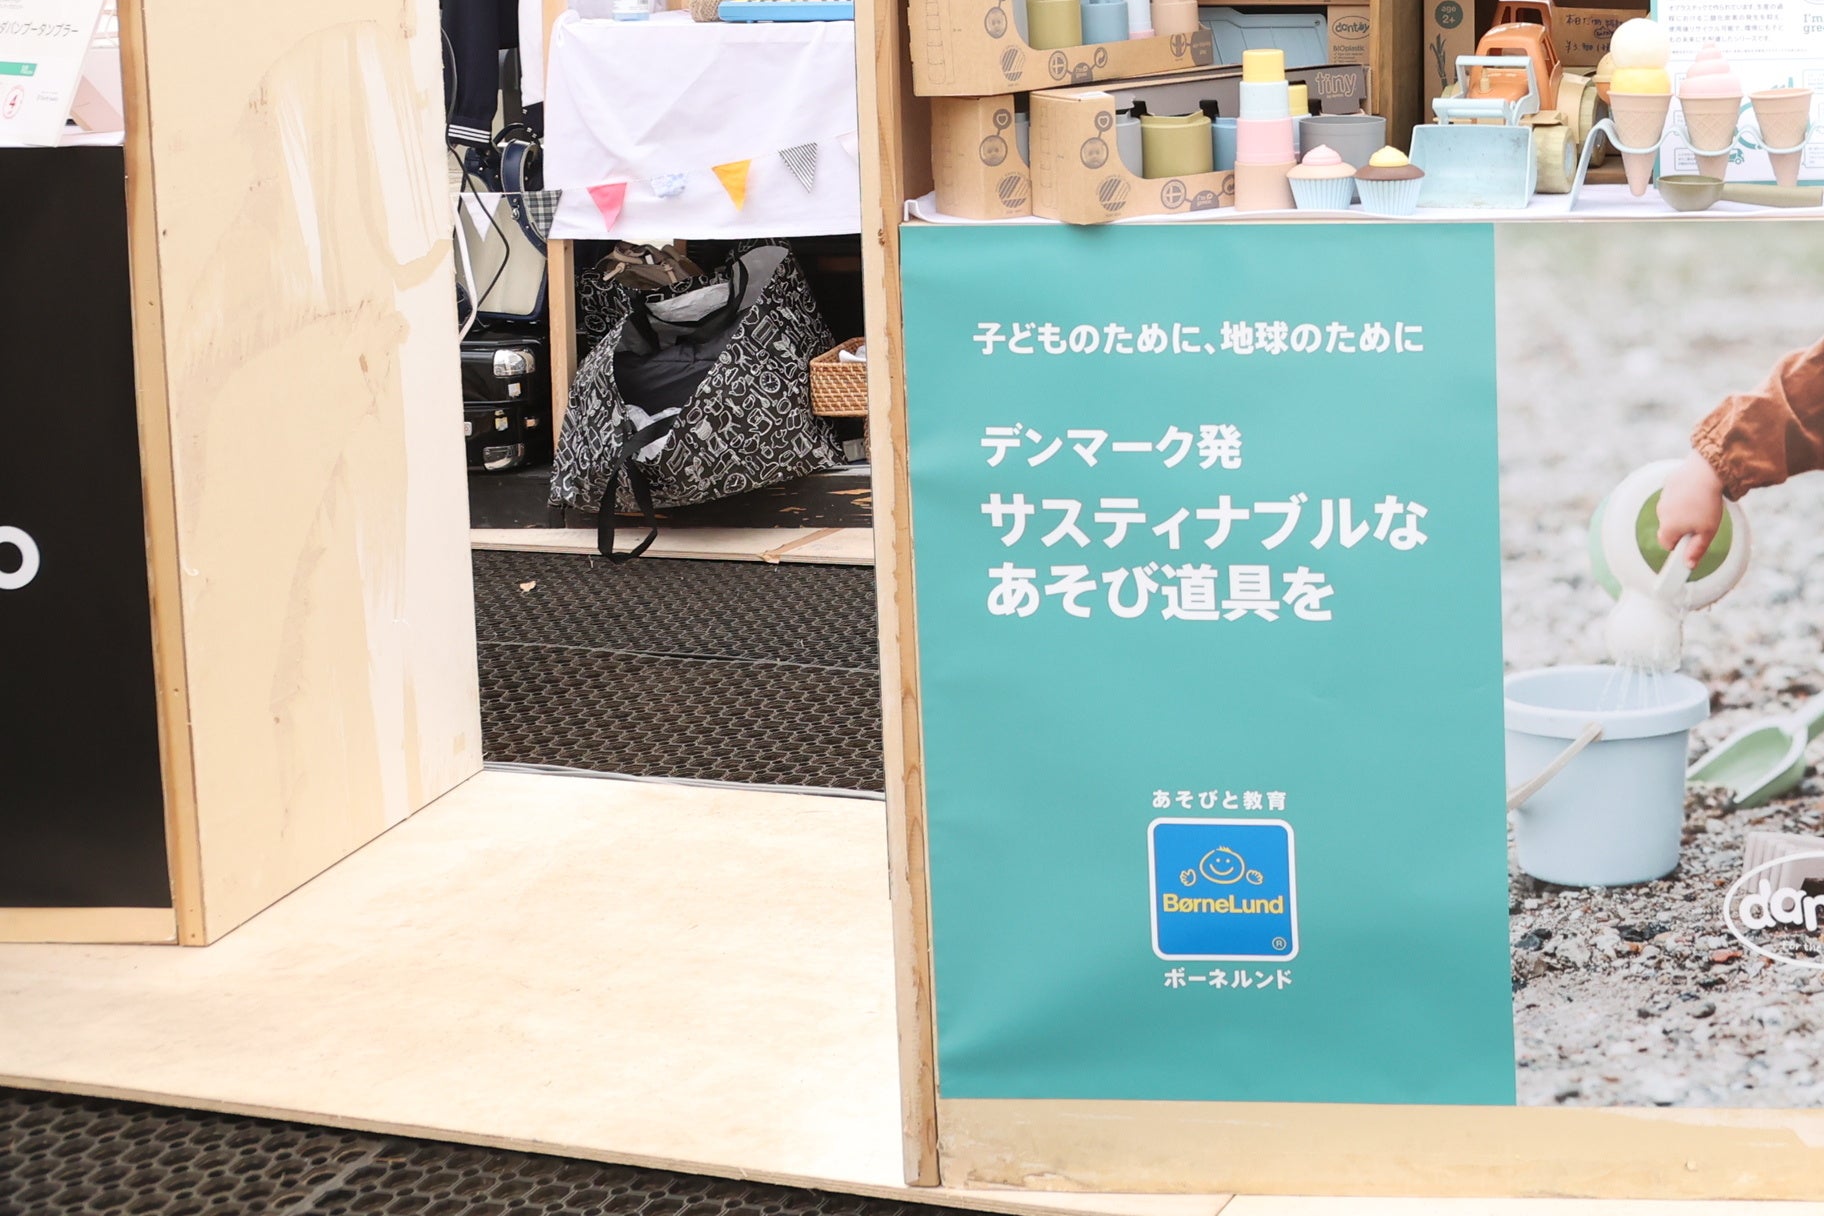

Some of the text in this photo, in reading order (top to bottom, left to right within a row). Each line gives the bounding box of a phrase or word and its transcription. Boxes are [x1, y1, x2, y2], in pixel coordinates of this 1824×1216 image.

[1441, 6, 1457, 14] age
[1442, 15, 1456, 24] 2+
[1803, 12, 1823, 23] I'm
[1335, 18, 1369, 34] dantoy
[1333, 45, 1364, 53] BIOplastic
[1315, 71, 1357, 97] tiny
[972, 320, 1425, 356] 子どものために、地球のために
[980, 422, 1243, 470] デンマーク発
[980, 491, 1430, 551] サスティナブルな
[985, 561, 1335, 622] あそび道具を
[1152, 789, 1287, 811] あそびと教育
[1162, 893, 1284, 915] BørneLund
[1164, 967, 1292, 990] ボーネルンド
